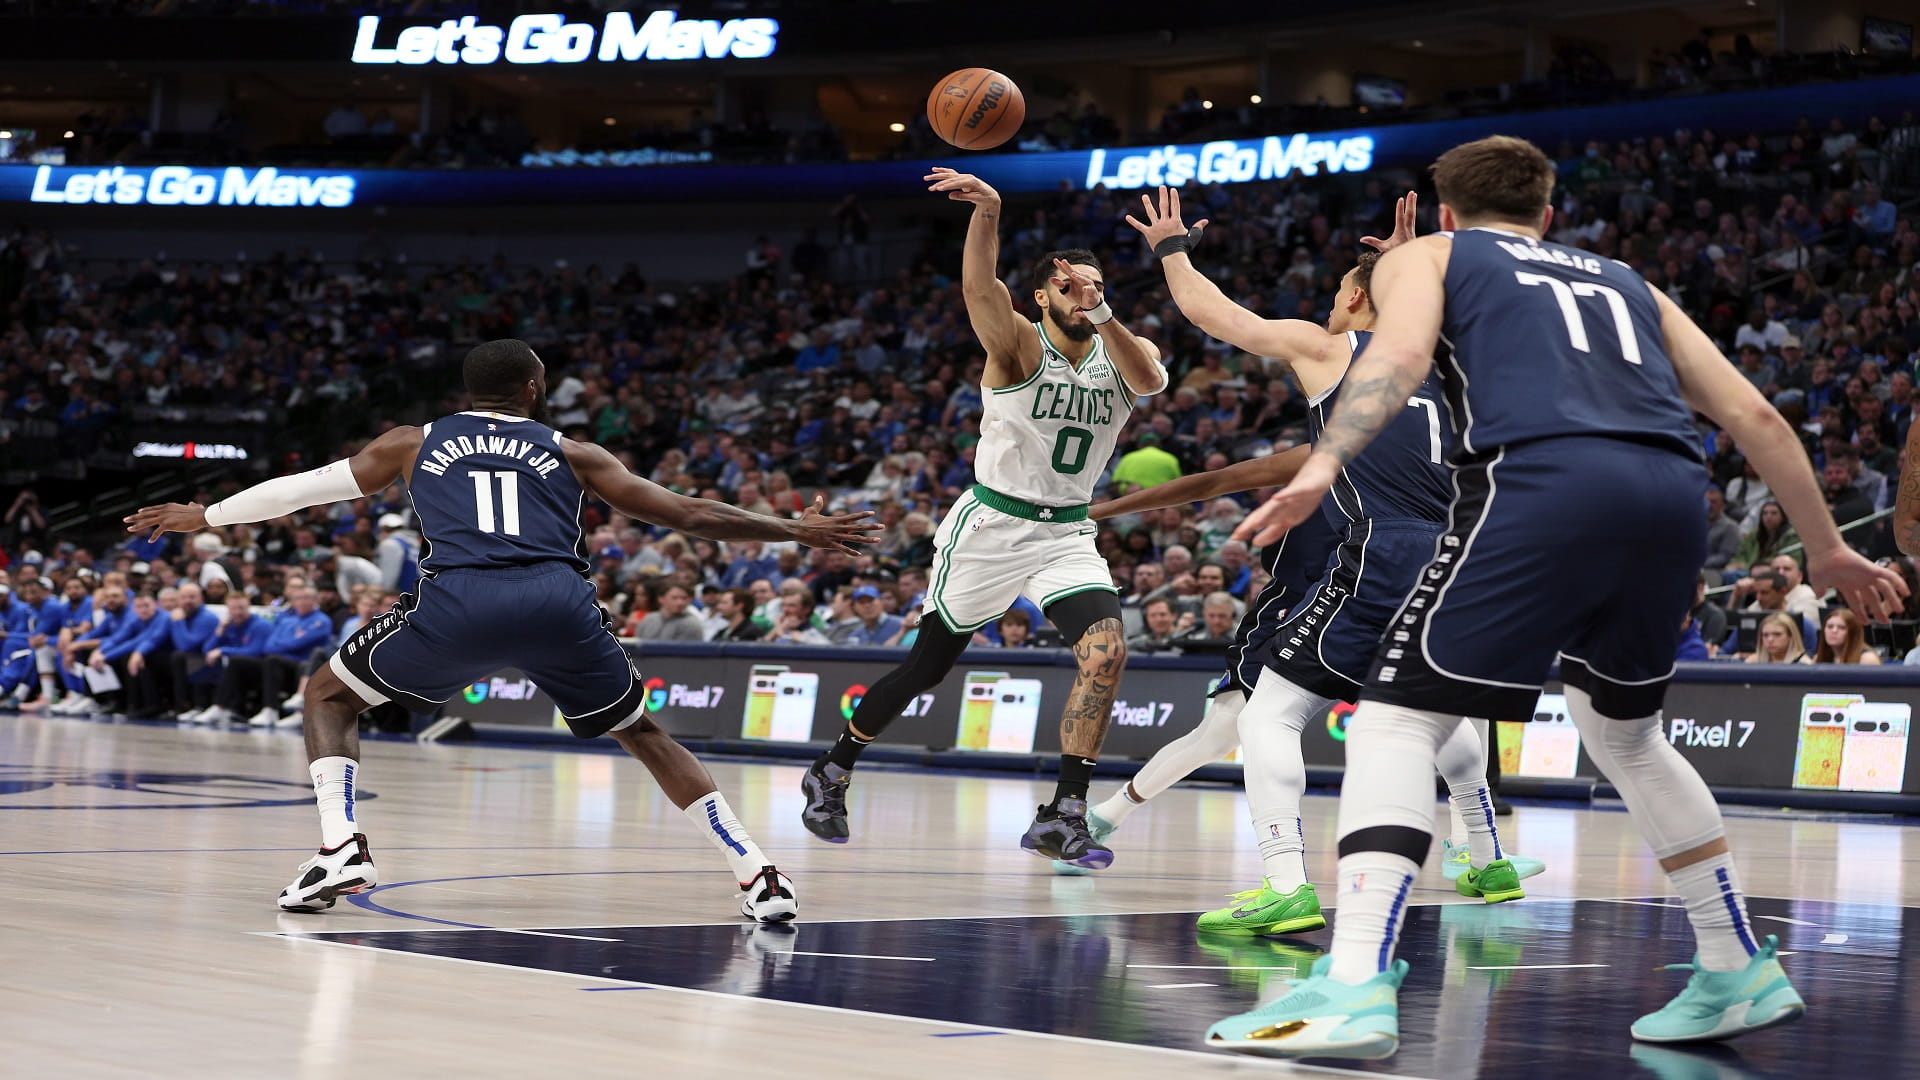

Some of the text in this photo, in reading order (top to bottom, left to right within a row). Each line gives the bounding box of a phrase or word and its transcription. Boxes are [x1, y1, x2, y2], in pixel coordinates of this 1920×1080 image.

[351, 10, 780, 65] Let's Go Mavs
[30, 164, 356, 208] Let's Go Mavs
[1085, 145, 1197, 190] Let's
[1197, 140, 1258, 184] Go
[1514, 271, 1643, 366] 77
[1087, 363, 1109, 375] VISTA
[1089, 371, 1111, 380] PRINT
[1031, 382, 1115, 425] CELTICS
[1052, 426, 1094, 475] 0
[1407, 396, 1442, 465] 7
[420, 435, 534, 477] HARDAWAY
[468, 471, 520, 536] 11
[489, 676, 526, 700] Pixel
[668, 684, 710, 708] Pixel
[711, 686, 725, 708] 7
[1109, 699, 1156, 727] Pixel
[1157, 702, 1174, 728] 7
[1669, 718, 1756, 748] Pixel 7
